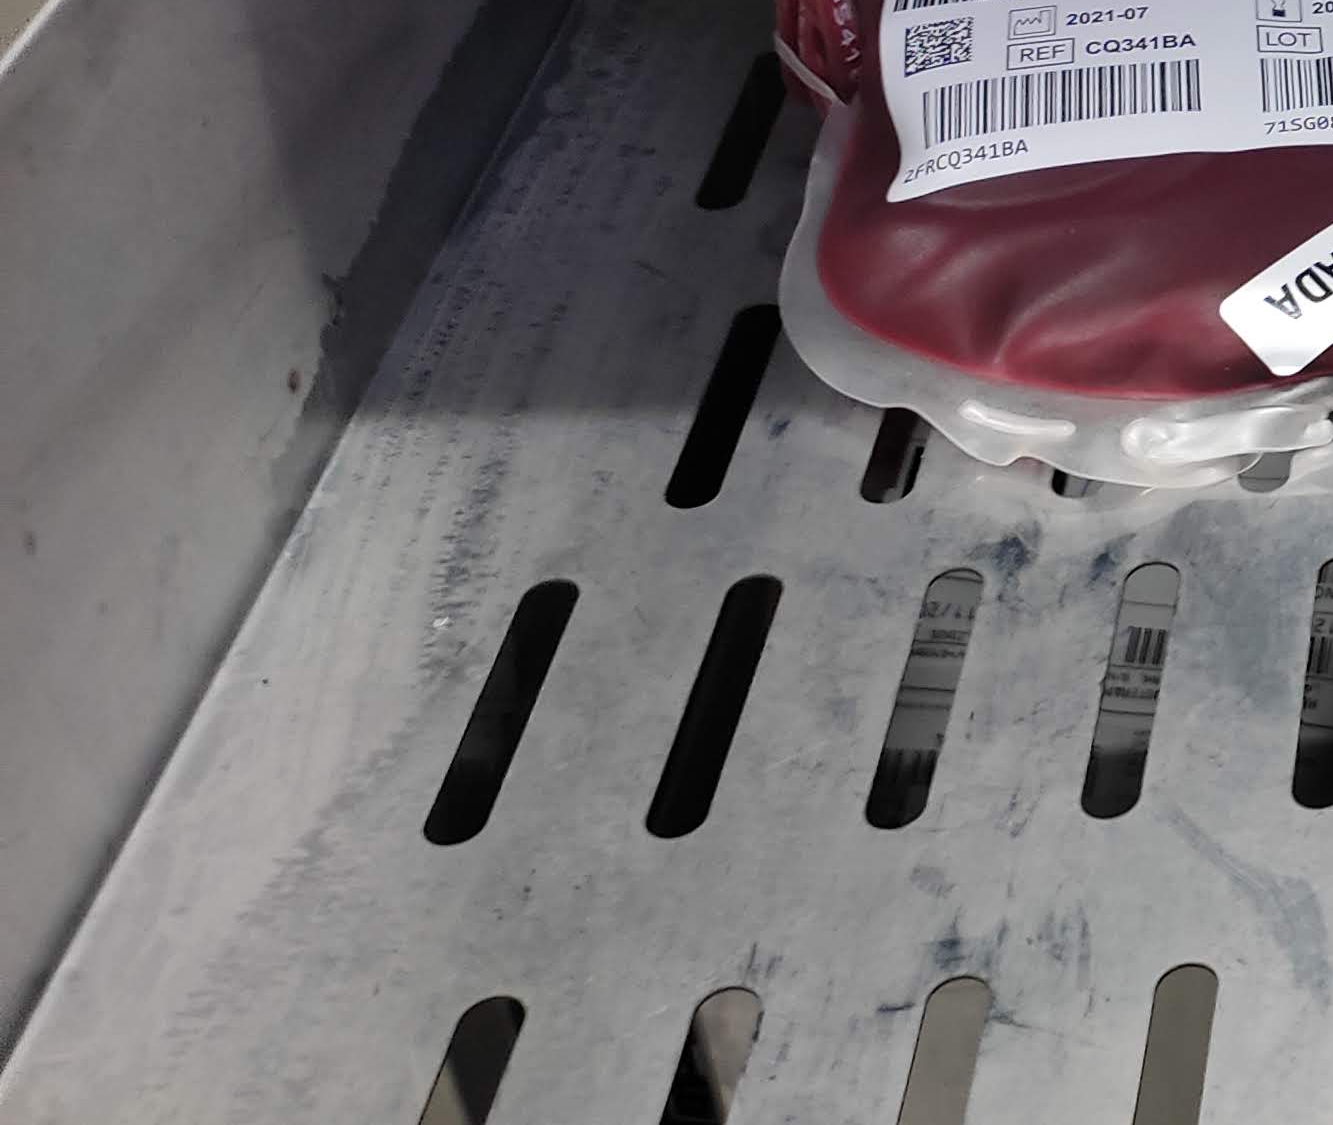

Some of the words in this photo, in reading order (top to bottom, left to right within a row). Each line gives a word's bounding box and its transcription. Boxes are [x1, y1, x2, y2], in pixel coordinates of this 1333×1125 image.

[1065, 6, 1150, 26] 2021-07
[1019, 46, 1067, 63] REF
[1084, 33, 1198, 55] CQ341BA
[1264, 31, 1313, 48] LOT
